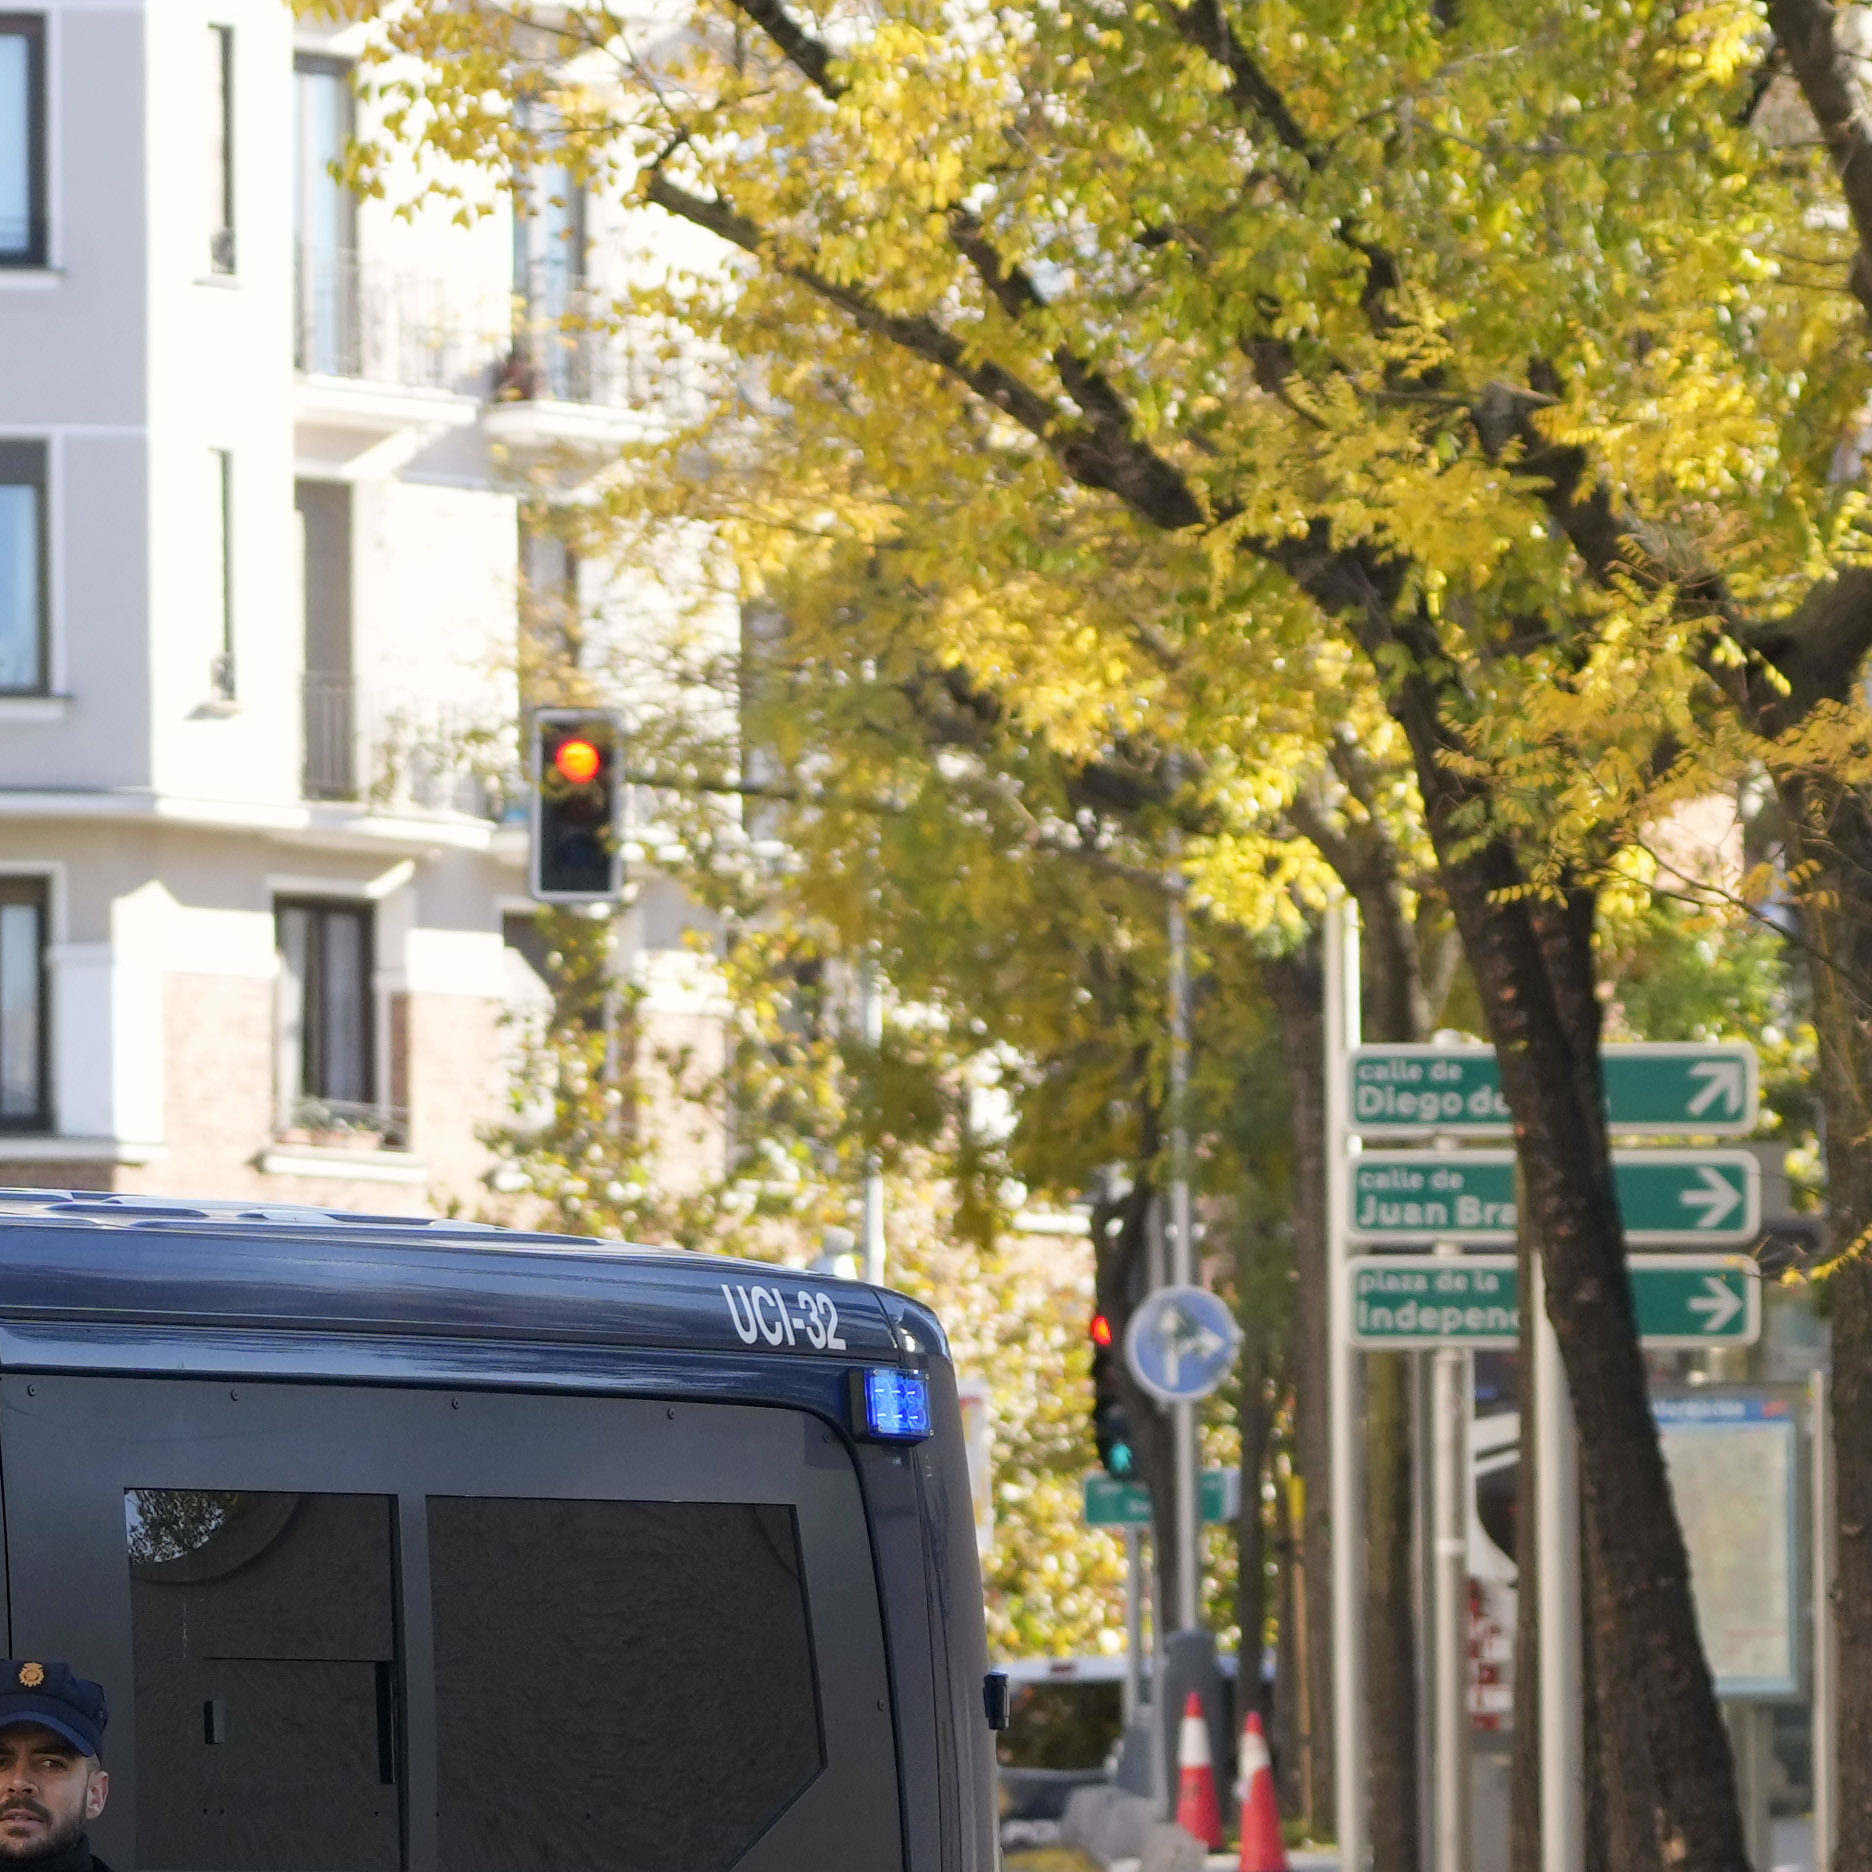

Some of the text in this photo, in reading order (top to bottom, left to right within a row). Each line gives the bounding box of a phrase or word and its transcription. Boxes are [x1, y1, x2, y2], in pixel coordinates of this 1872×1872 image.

[1358, 1060, 1463, 1082] calle de
[1358, 1085, 1464, 1122] Diego
[1359, 1168, 1465, 1190] calle de
[1359, 1194, 1518, 1226] Juan Bra
[1435, 1269, 1468, 1292] de
[1474, 1269, 1500, 1291] la
[721, 1283, 847, 1351] UCI-32
